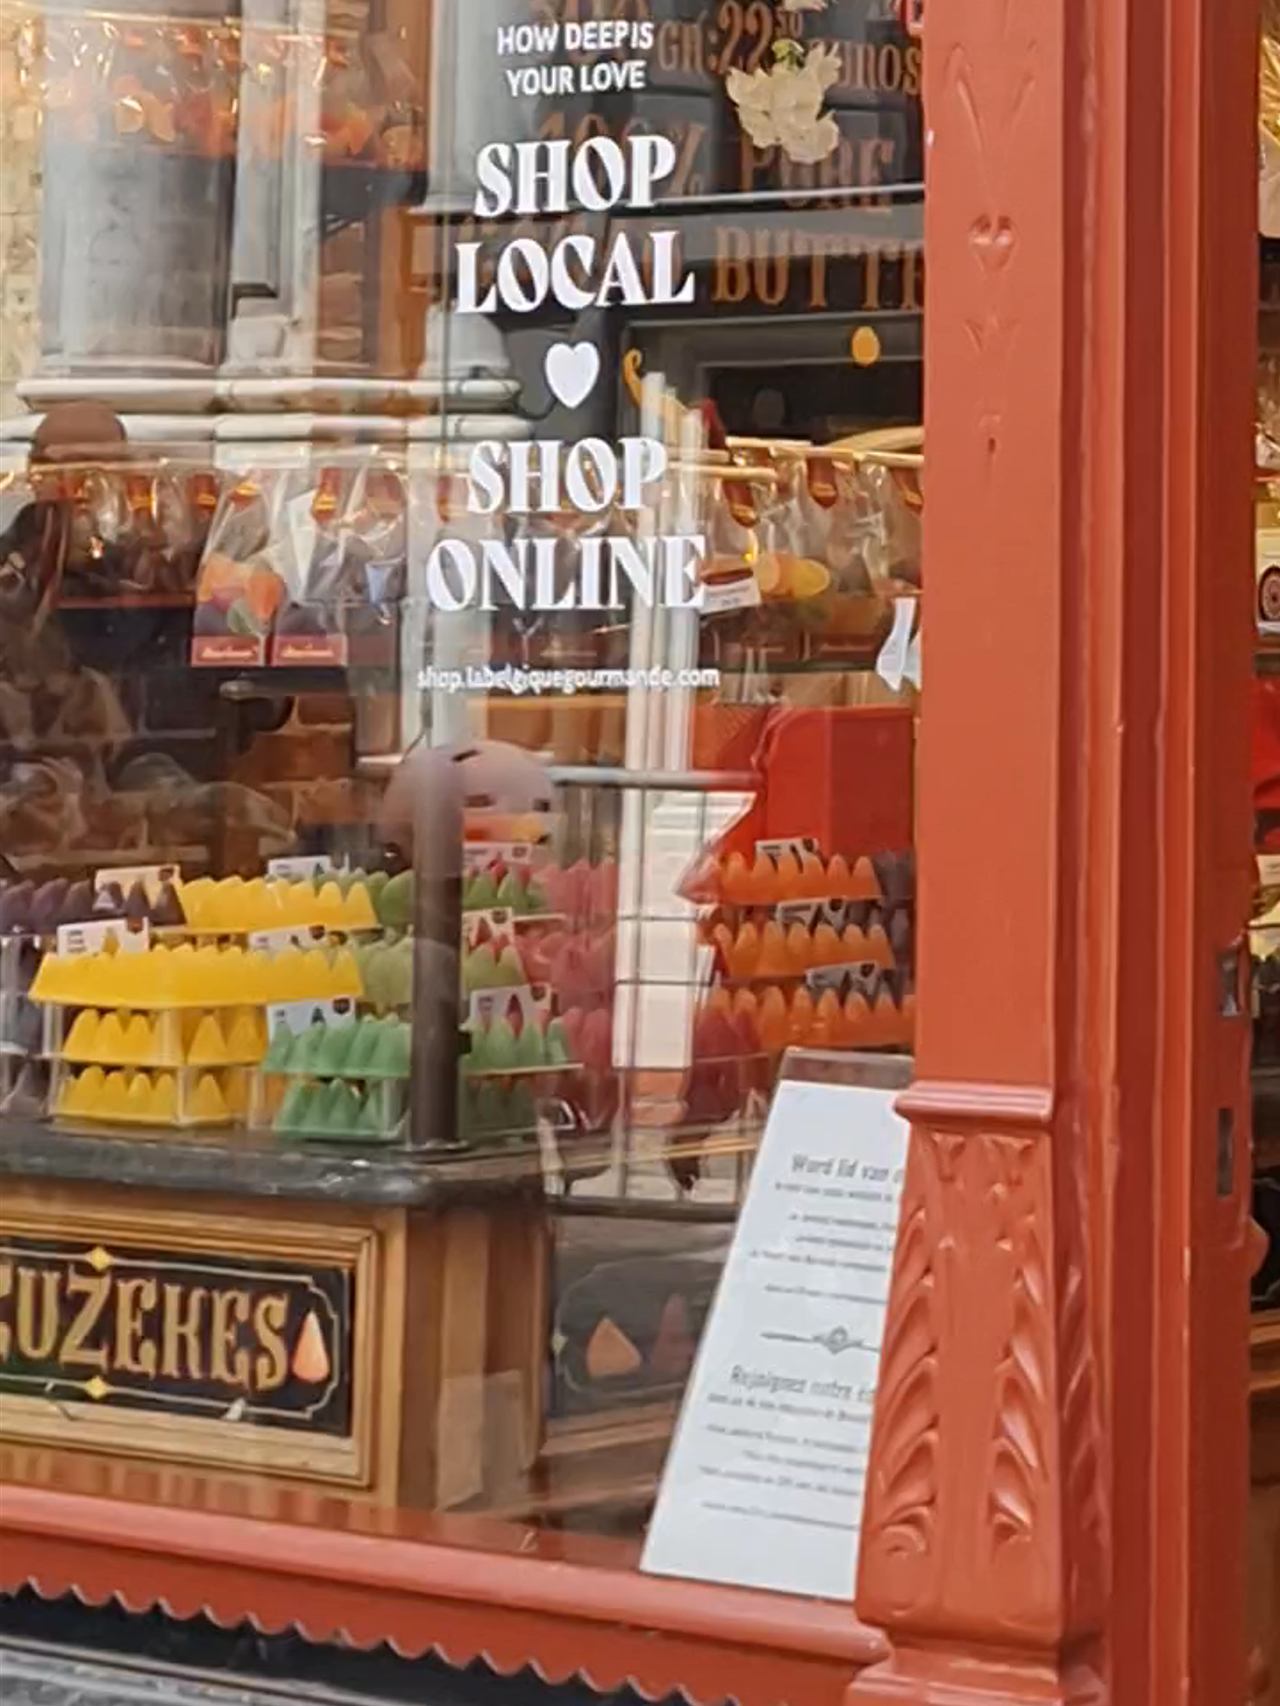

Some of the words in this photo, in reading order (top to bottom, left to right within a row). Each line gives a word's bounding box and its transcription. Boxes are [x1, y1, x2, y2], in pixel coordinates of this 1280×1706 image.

[497, 24, 558, 56] HOW
[564, 22, 629, 51] DEEP
[630, 20, 655, 49] IS
[506, 65, 575, 98] YOUR
[579, 60, 647, 93] LOVE
[473, 134, 677, 218] SHOP
[454, 229, 695, 314] LOCAL
[466, 436, 669, 514] SHOP
[426, 534, 706, 612] ONLINE
[416, 663, 721, 697] shop.labelgiquegourmande.com
